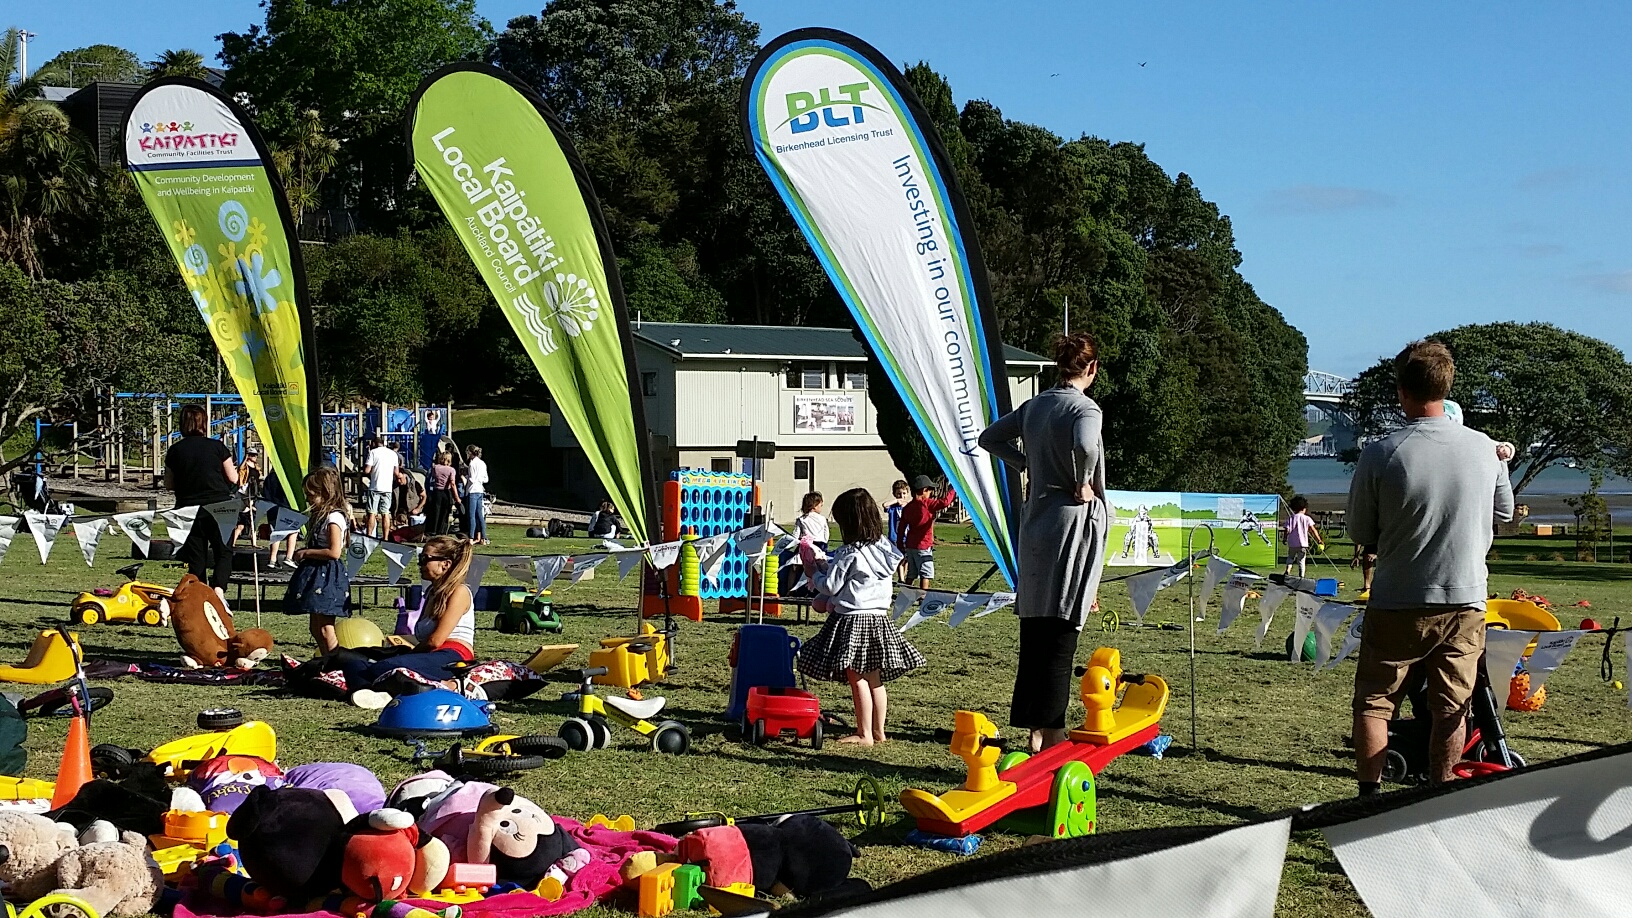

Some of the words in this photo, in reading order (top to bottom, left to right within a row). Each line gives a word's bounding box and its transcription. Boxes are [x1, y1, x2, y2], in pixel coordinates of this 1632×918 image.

[785, 82, 870, 134] BLT
[147, 151, 185, 159] Community
[776, 139, 826, 154] Birkenhead
[827, 132, 869, 146] Licensing
[871, 128, 894, 138] Trust
[154, 174, 200, 185] Community
[202, 173, 255, 184] Development
[157, 188, 172, 197] and
[172, 186, 211, 197] Wellbeing
[212, 185, 220, 194] in
[221, 185, 255, 195] Kaipatiki
[431, 126, 493, 205] Local
[476, 200, 541, 287] Board
[892, 154, 938, 256] Investing
[465, 216, 494, 258] Auckland
[491, 258, 517, 294] Council
[928, 257, 947, 281] in
[934, 286, 956, 323] our
[944, 330, 980, 458] community
